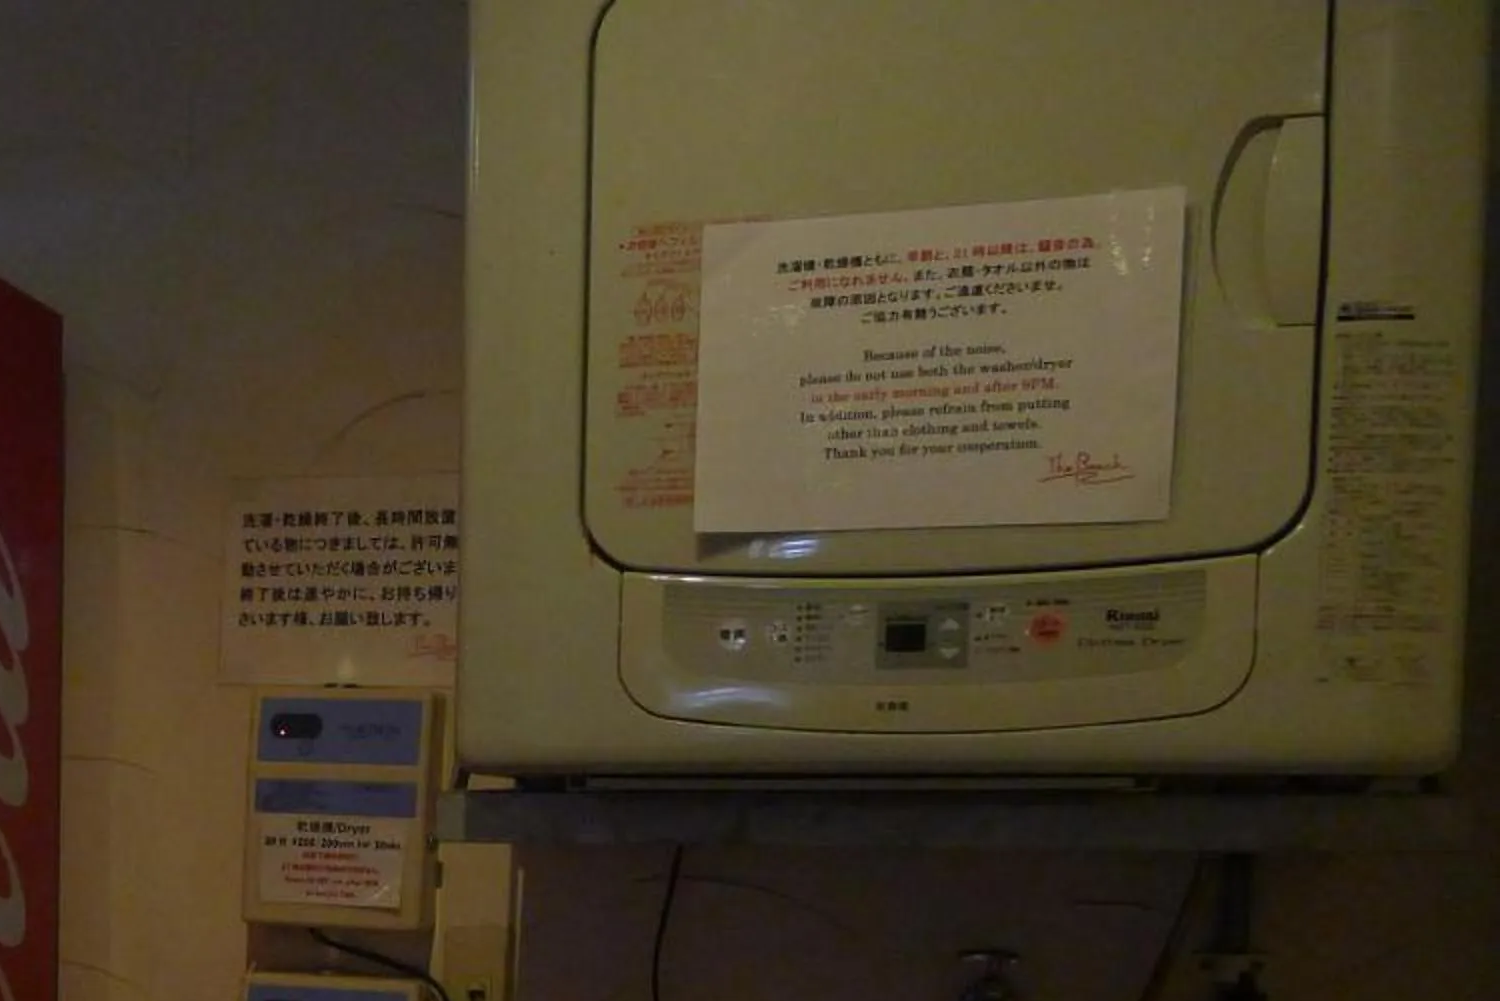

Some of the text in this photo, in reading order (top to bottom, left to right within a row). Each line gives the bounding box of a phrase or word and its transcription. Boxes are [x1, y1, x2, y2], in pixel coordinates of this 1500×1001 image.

[864, 348, 919, 362] Because
[923, 345, 937, 360] of
[939, 344, 962, 358] the
[799, 371, 841, 387] please
[845, 369, 861, 382] do
[865, 368, 886, 381] not
[918, 362, 948, 378] both
[952, 361, 975, 376] the
[828, 388, 849, 403] the
[892, 382, 950, 401] morning
[953, 380, 979, 395] and
[984, 378, 1017, 393] after
[882, 403, 925, 421] please
[980, 398, 1013, 414] from
[1017, 396, 1070, 414] putting
[902, 419, 958, 438] clothing
[961, 418, 988, 434] and
[824, 445, 866, 460] Thank
[870, 446, 896, 461] you
[899, 443, 919, 457] for
[922, 442, 954, 458] your
